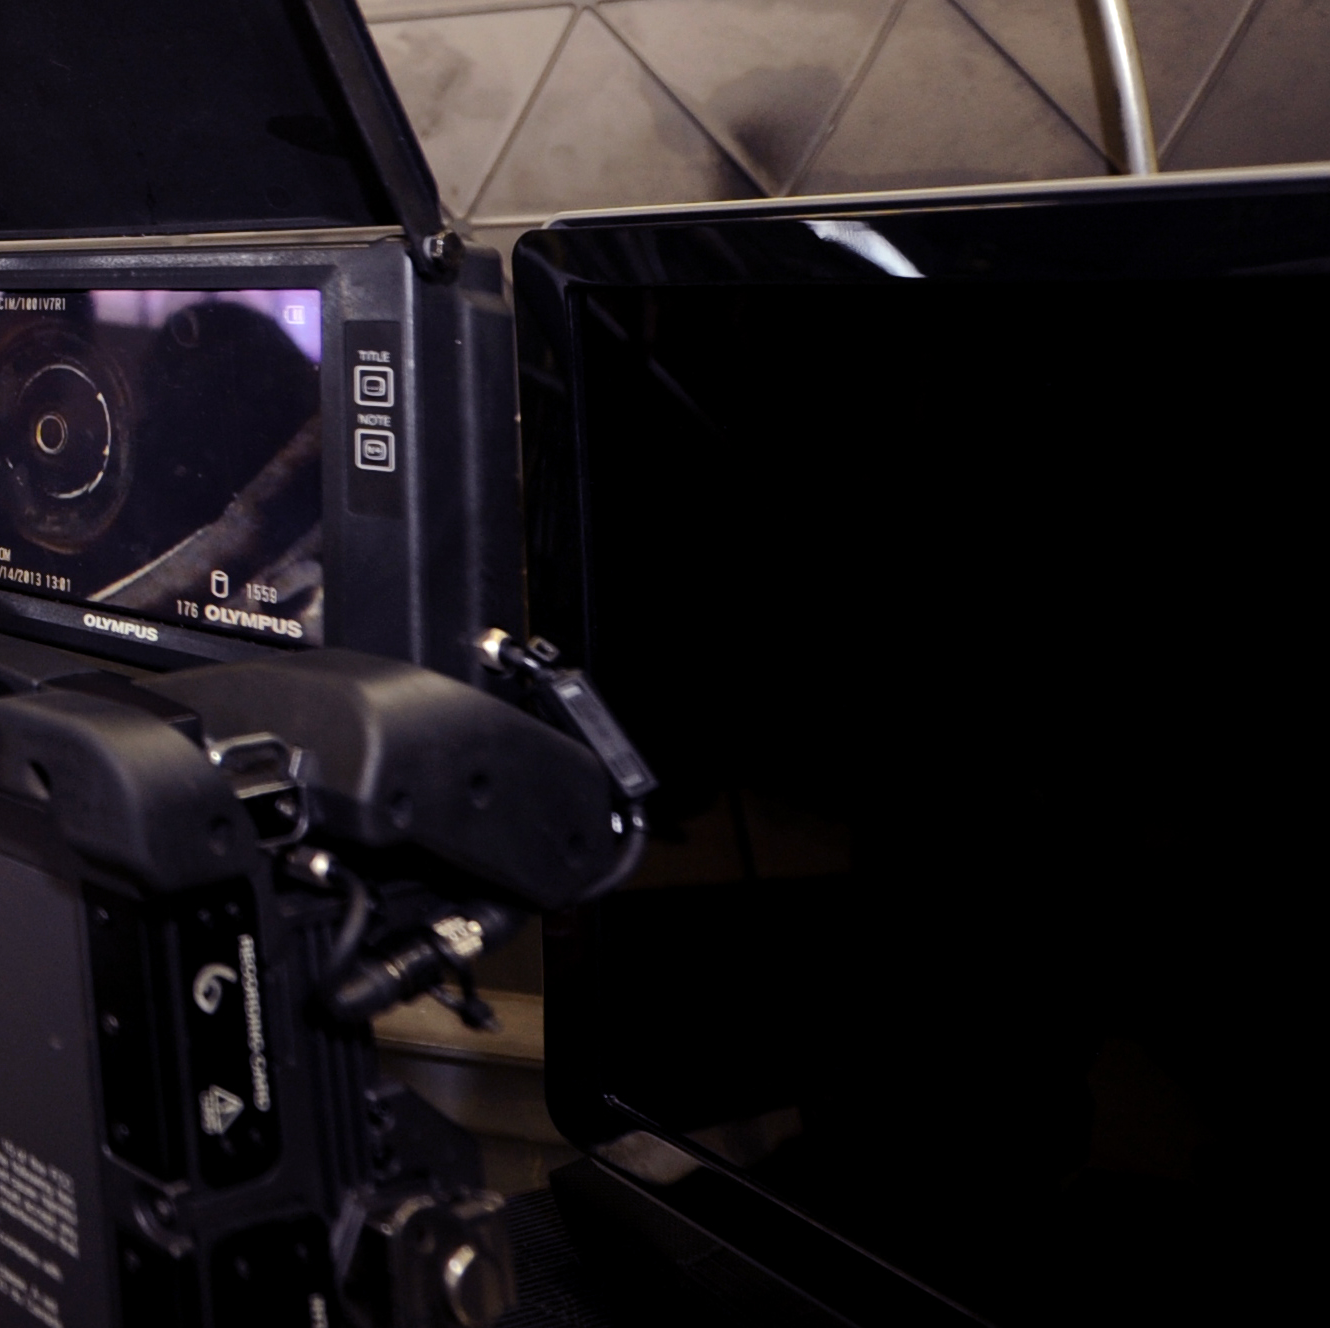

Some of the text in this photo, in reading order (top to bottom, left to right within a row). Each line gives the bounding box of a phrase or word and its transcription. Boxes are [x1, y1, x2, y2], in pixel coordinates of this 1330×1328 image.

[358, 350, 391, 363] TITLE
[357, 414, 391, 427] NOTE
[246, 582, 278, 604] 1559
[83, 613, 159, 642] OLYMPUS
[176, 599, 303, 639] 176 OLYMPUS
